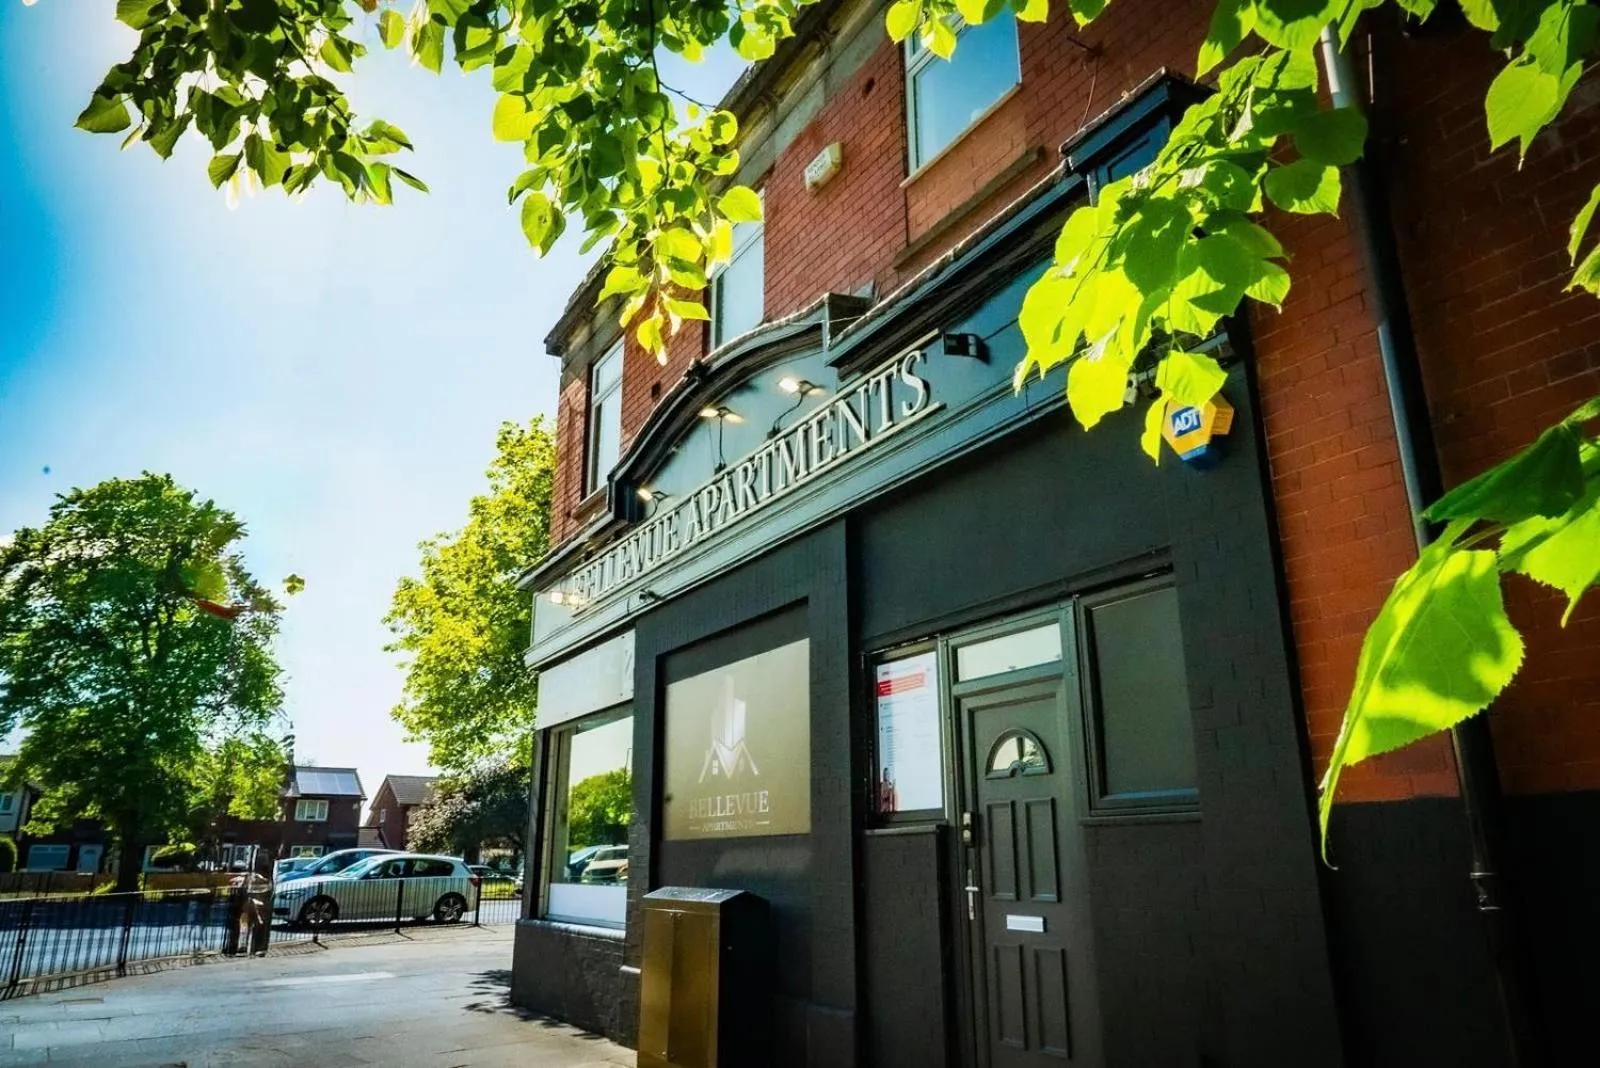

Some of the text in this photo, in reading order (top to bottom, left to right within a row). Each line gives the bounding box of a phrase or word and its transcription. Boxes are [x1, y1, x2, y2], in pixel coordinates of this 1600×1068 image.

[1174, 409, 1199, 434] ADT
[573, 350, 930, 601] BELLEVUE APARTMENTS
[689, 791, 769, 818] BELLEVUE
